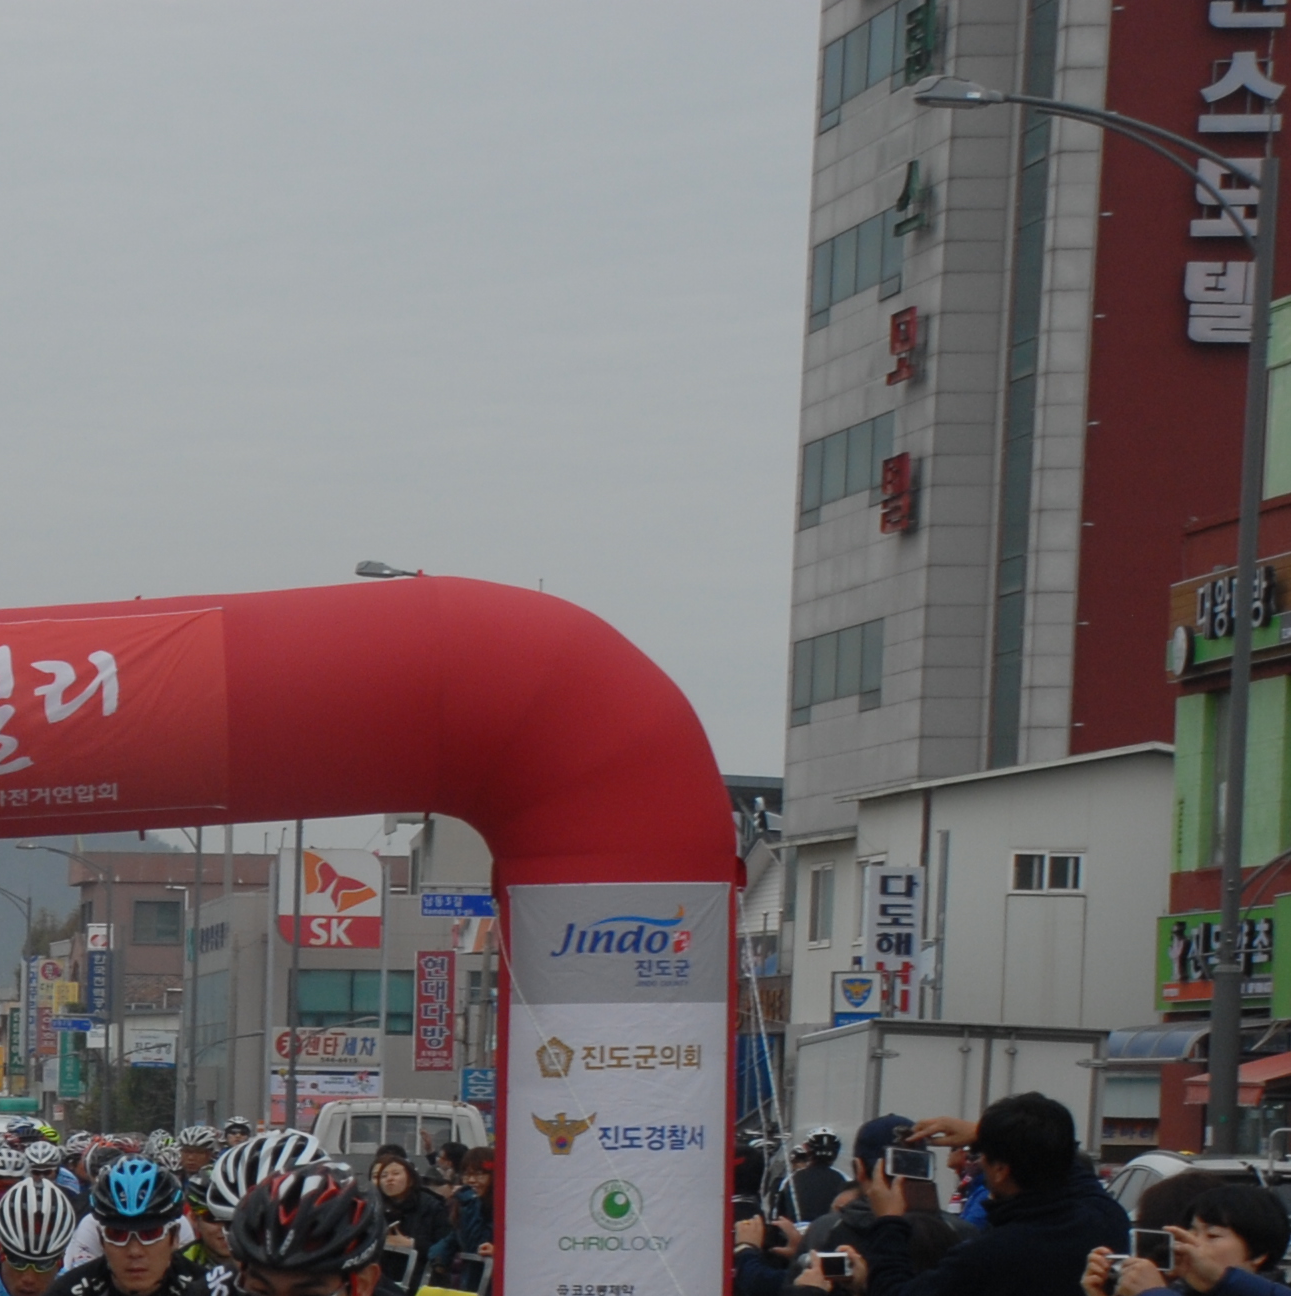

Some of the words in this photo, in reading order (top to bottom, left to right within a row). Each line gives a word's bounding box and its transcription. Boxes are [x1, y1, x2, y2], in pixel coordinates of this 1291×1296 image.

[876, 875, 919, 956] 다도해
[308, 916, 353, 947] SK
[551, 923, 669, 957] Jindo
[634, 959, 691, 978] 진도군
[420, 955, 450, 1049] 현대다방
[581, 1044, 702, 1070] 진도군의회
[597, 1125, 705, 1151] 진도경찰서
[558, 1235, 672, 1252] CHRIOLOGY
